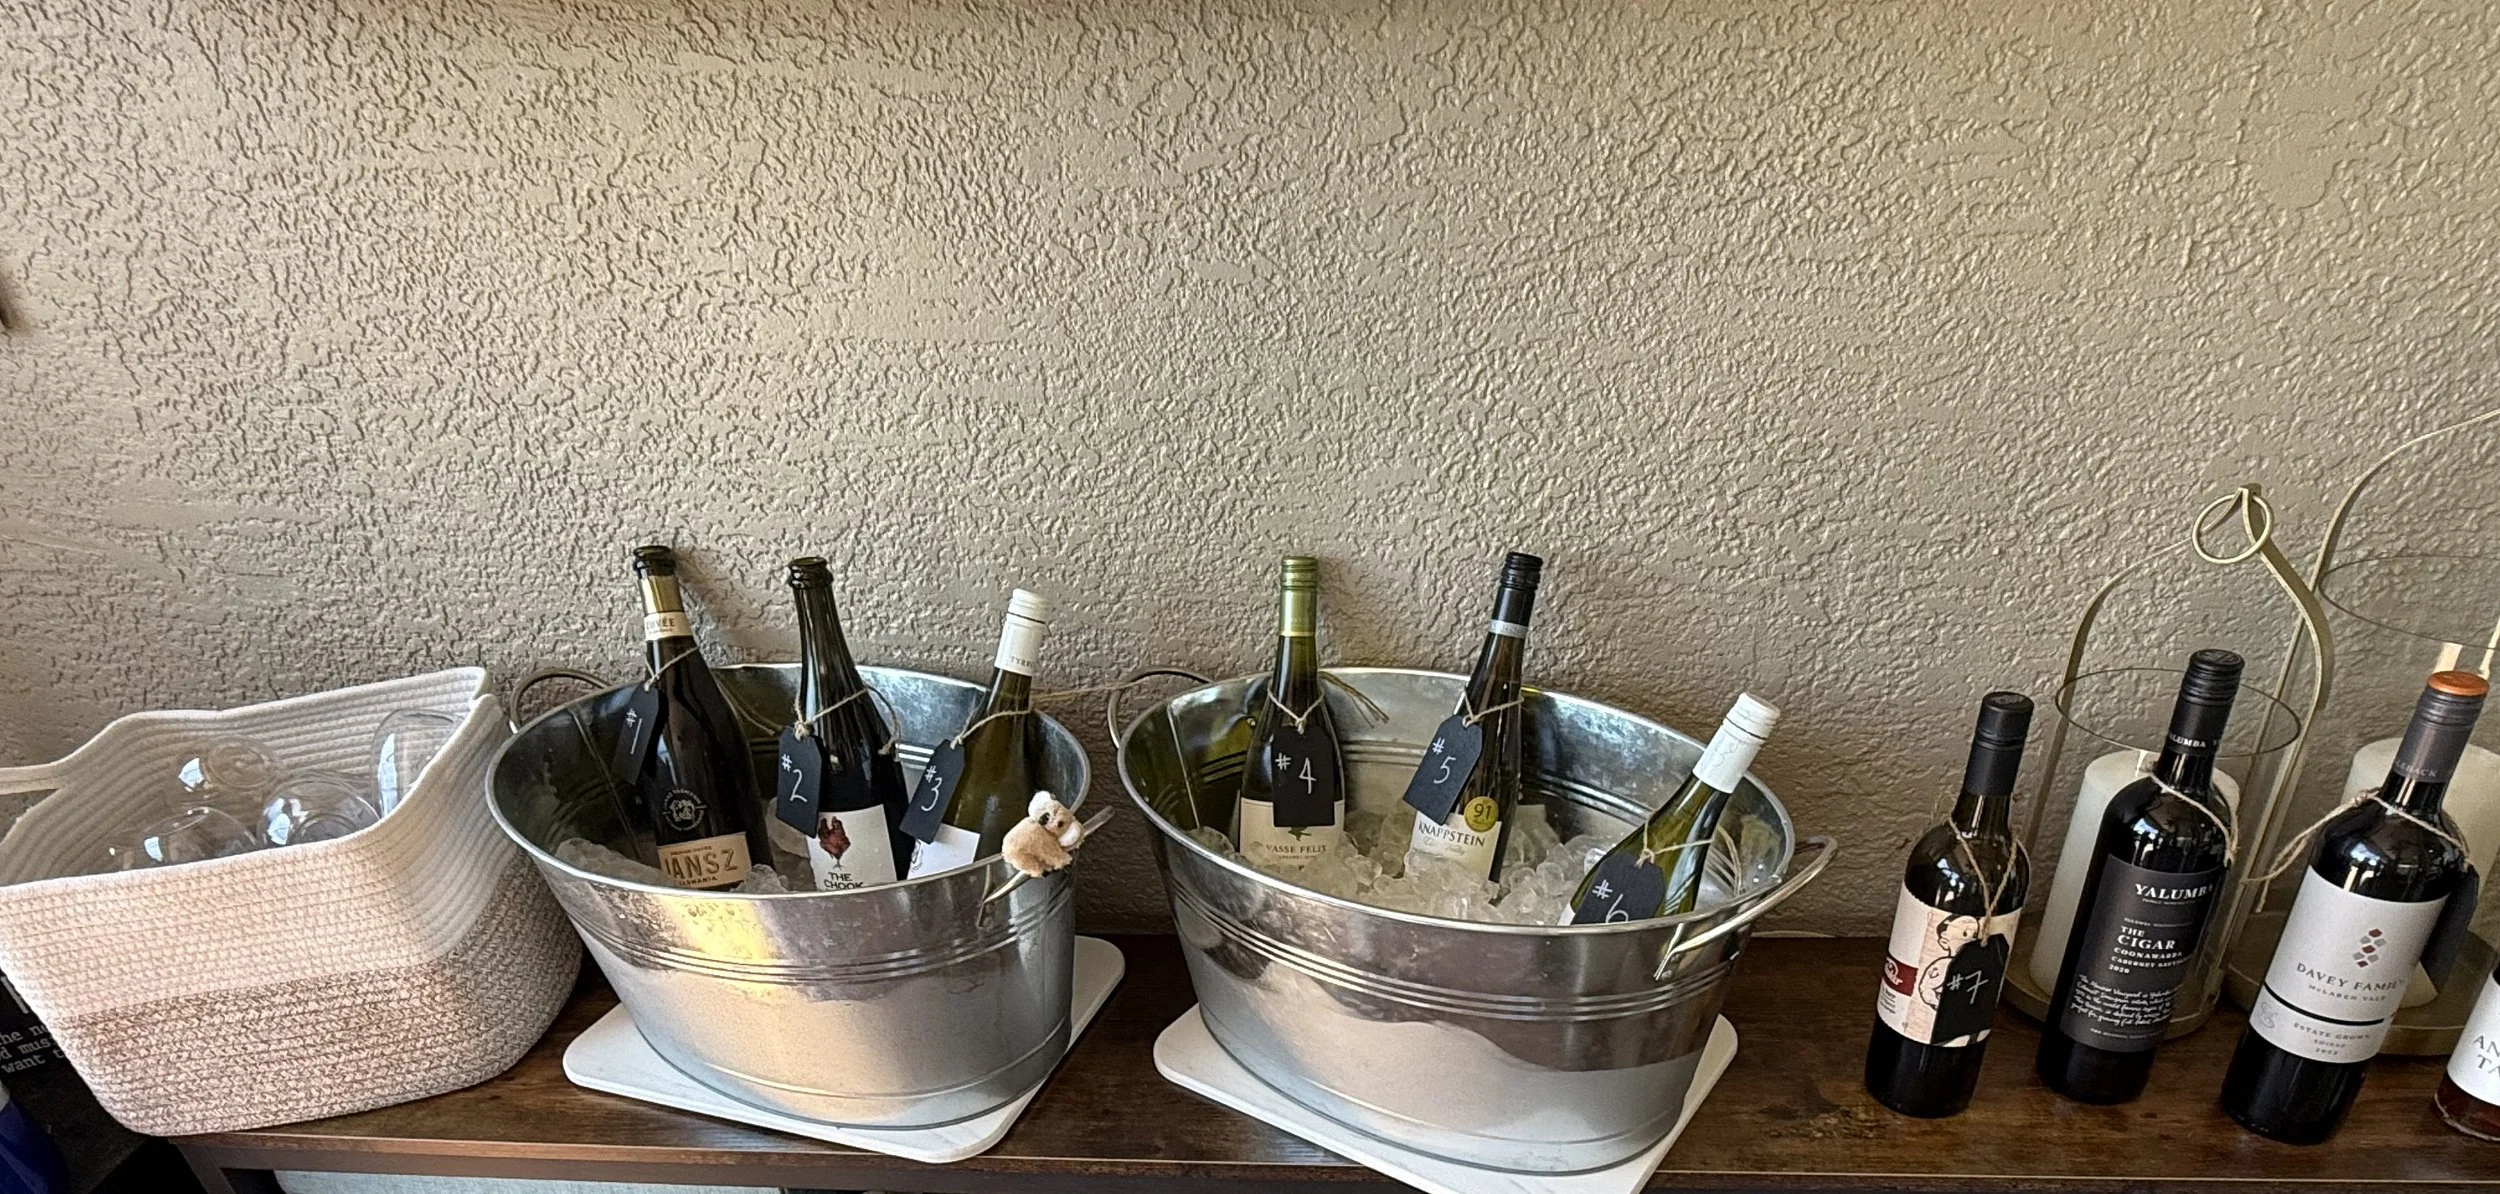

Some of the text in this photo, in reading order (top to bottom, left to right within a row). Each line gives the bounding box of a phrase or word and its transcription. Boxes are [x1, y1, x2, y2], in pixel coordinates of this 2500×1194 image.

[625, 707, 643, 755] #1
[1275, 752, 1317, 795] #4
[1432, 737, 1457, 785] #5
[781, 753, 808, 803] #2
[920, 765, 943, 812] #3
[1473, 803, 1492, 821] 91
[1418, 821, 1486, 847] KNAPPSTEIN
[1299, 844, 1328, 854] FELIX
[828, 871, 853, 883] THE
[1591, 879, 1630, 923] #6
[2117, 934, 2176, 950] CIGAR
[2120, 925, 2145, 938] THE
[2108, 963, 2130, 974] 2020
[2297, 962, 2349, 988] DAVEY
[1946, 969, 1989, 1005] #7
[2293, 1021, 2331, 1039] ESTATE
[1, 1054, 46, 1074] want
